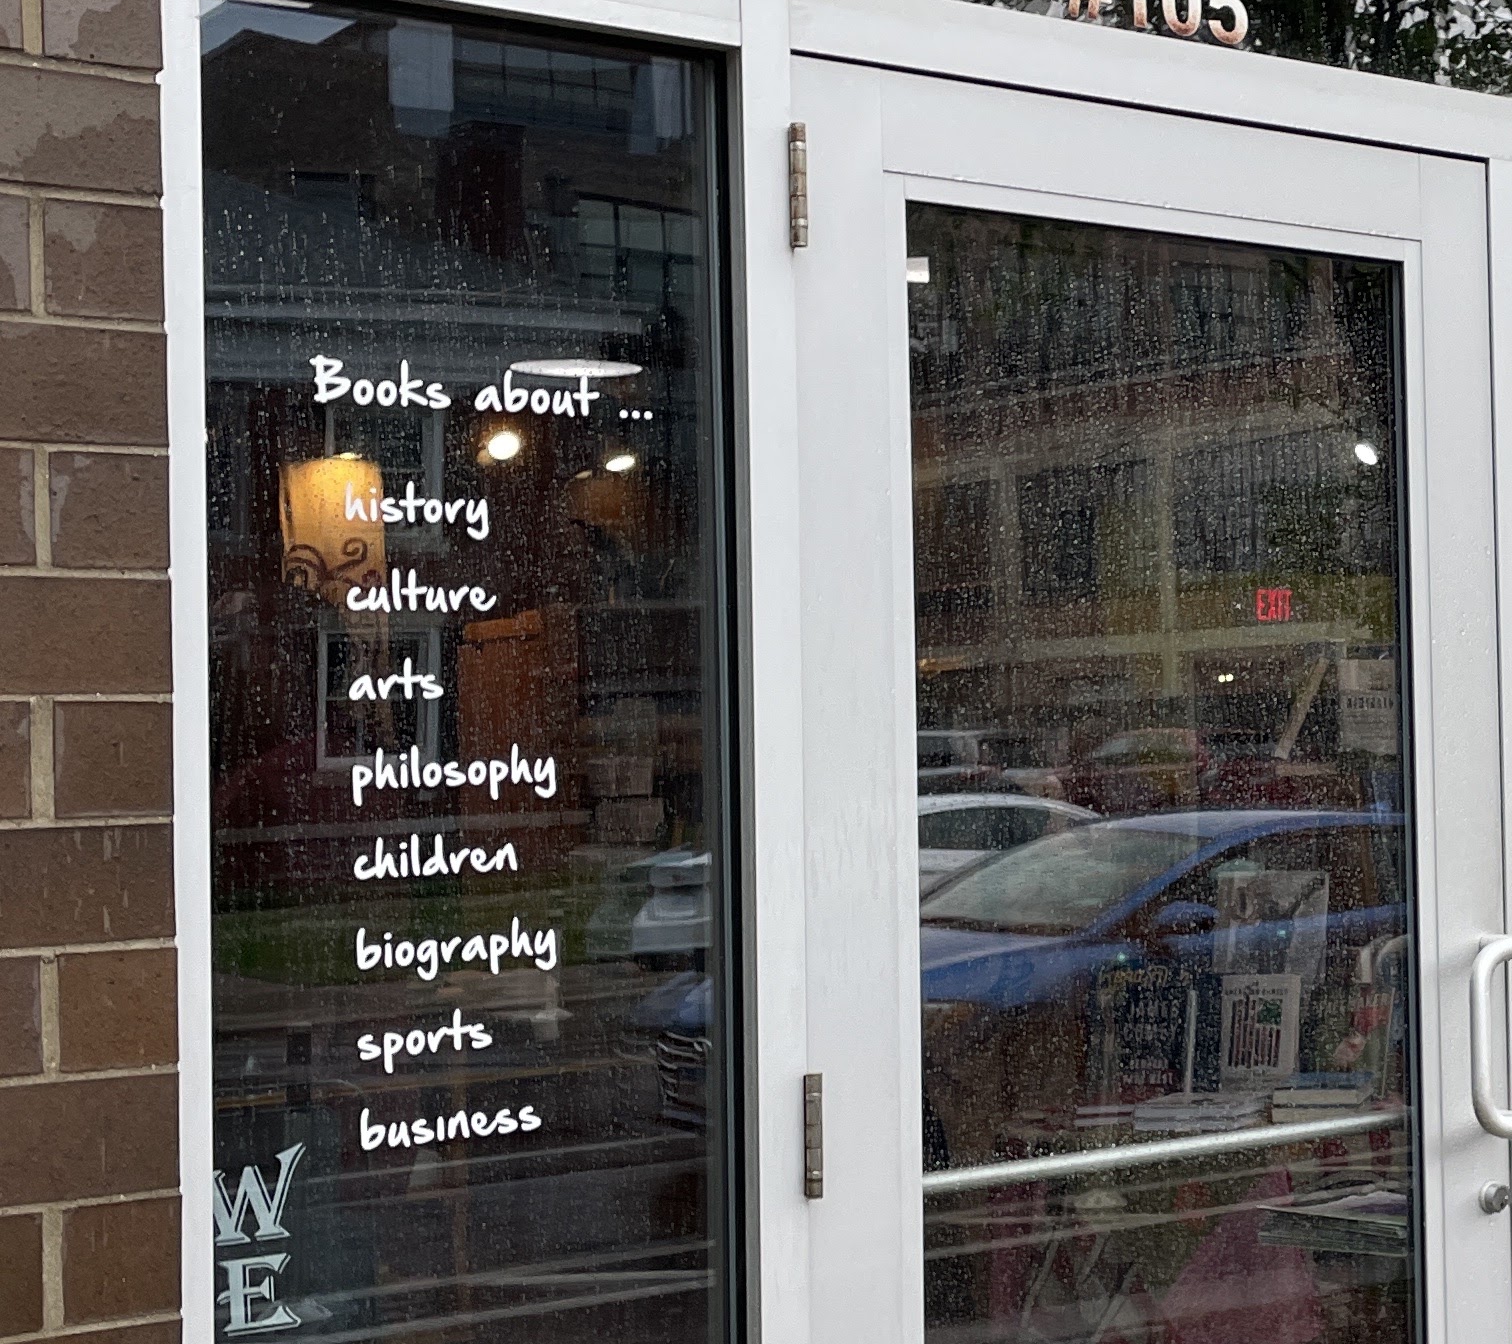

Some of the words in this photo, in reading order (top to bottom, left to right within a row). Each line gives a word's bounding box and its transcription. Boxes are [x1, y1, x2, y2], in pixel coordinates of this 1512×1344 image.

[309, 354, 451, 409] Books
[474, 374, 600, 418] about
[343, 481, 490, 540] history
[346, 573, 498, 613] culture
[1256, 588, 1293, 622] EXIT
[348, 659, 444, 702] arts
[352, 743, 557, 807] philosophy
[353, 832, 519, 880] children
[356, 916, 557, 981] biography
[357, 1009, 493, 1073] sports
[360, 1104, 542, 1151] business
